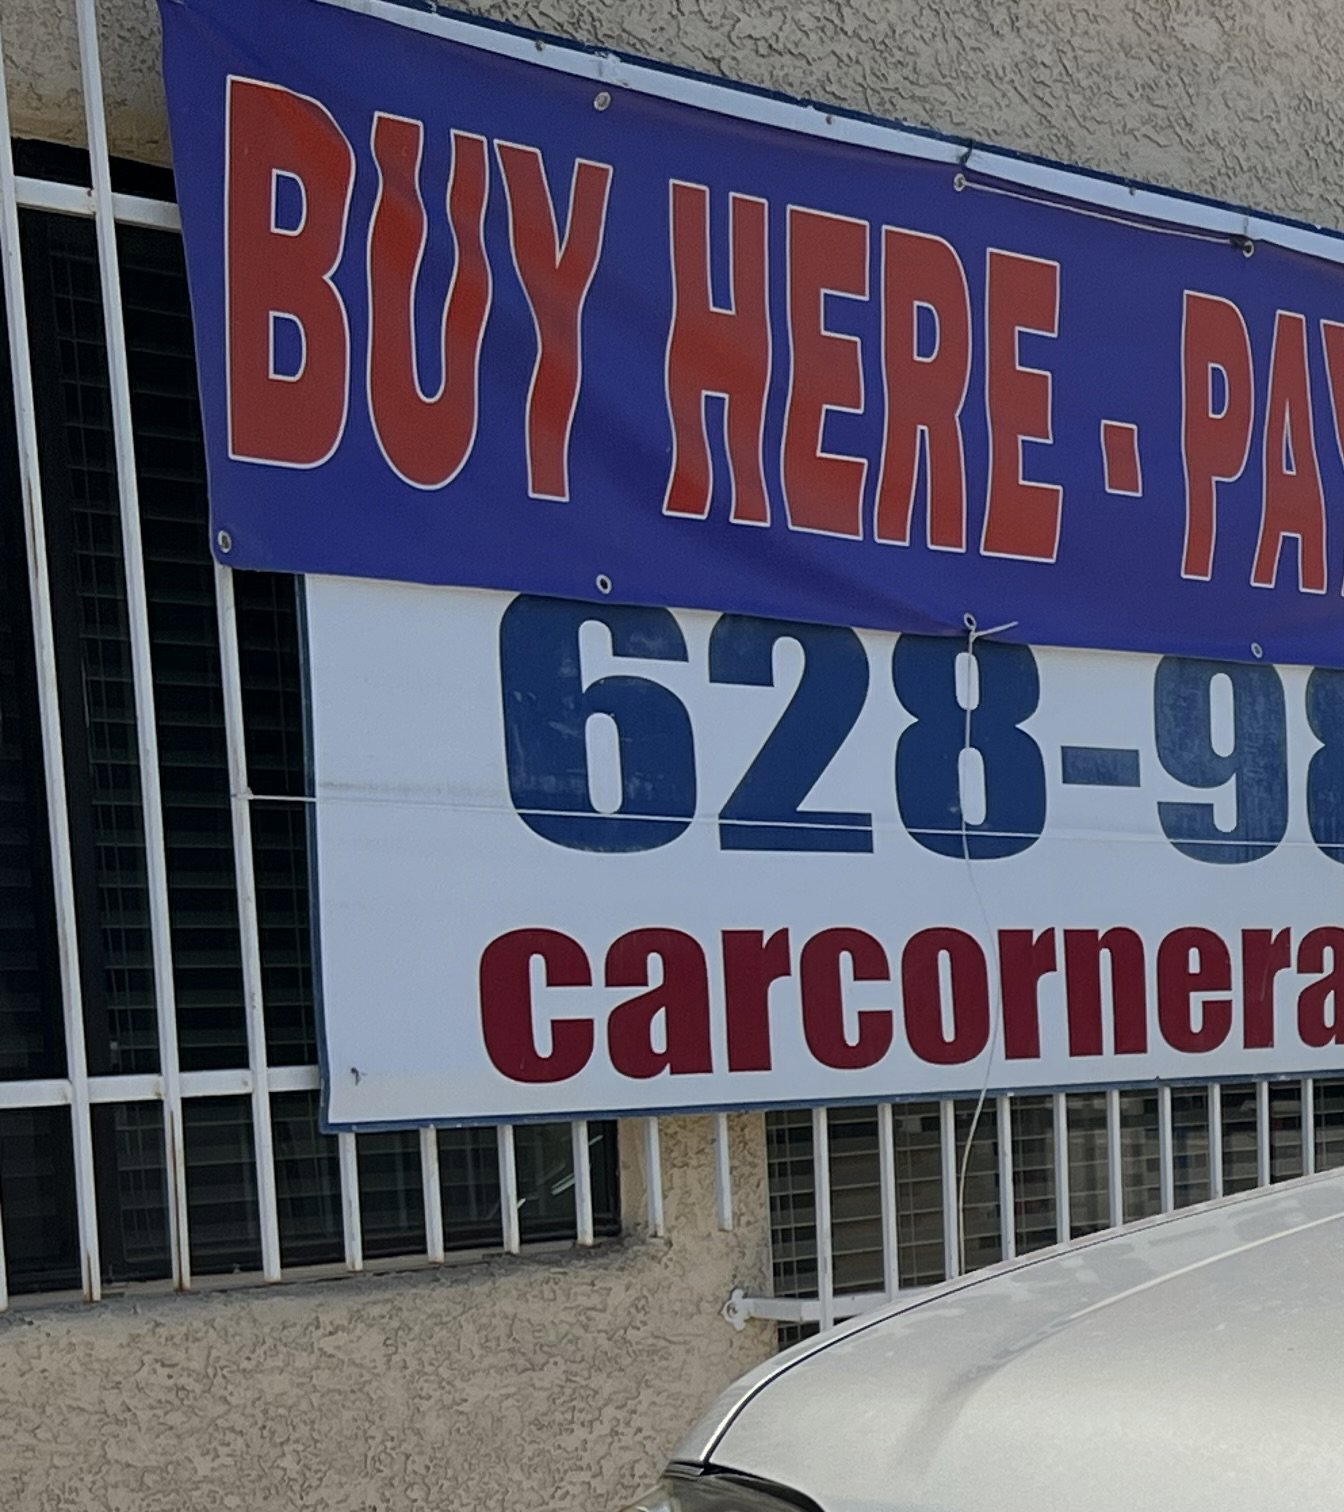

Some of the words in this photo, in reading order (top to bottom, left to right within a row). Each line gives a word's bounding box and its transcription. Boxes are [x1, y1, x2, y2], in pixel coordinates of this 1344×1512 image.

[225, 74, 613, 502] BUY
[662, 178, 1063, 563] HERE
[1100, 419, 1143, 497] -
